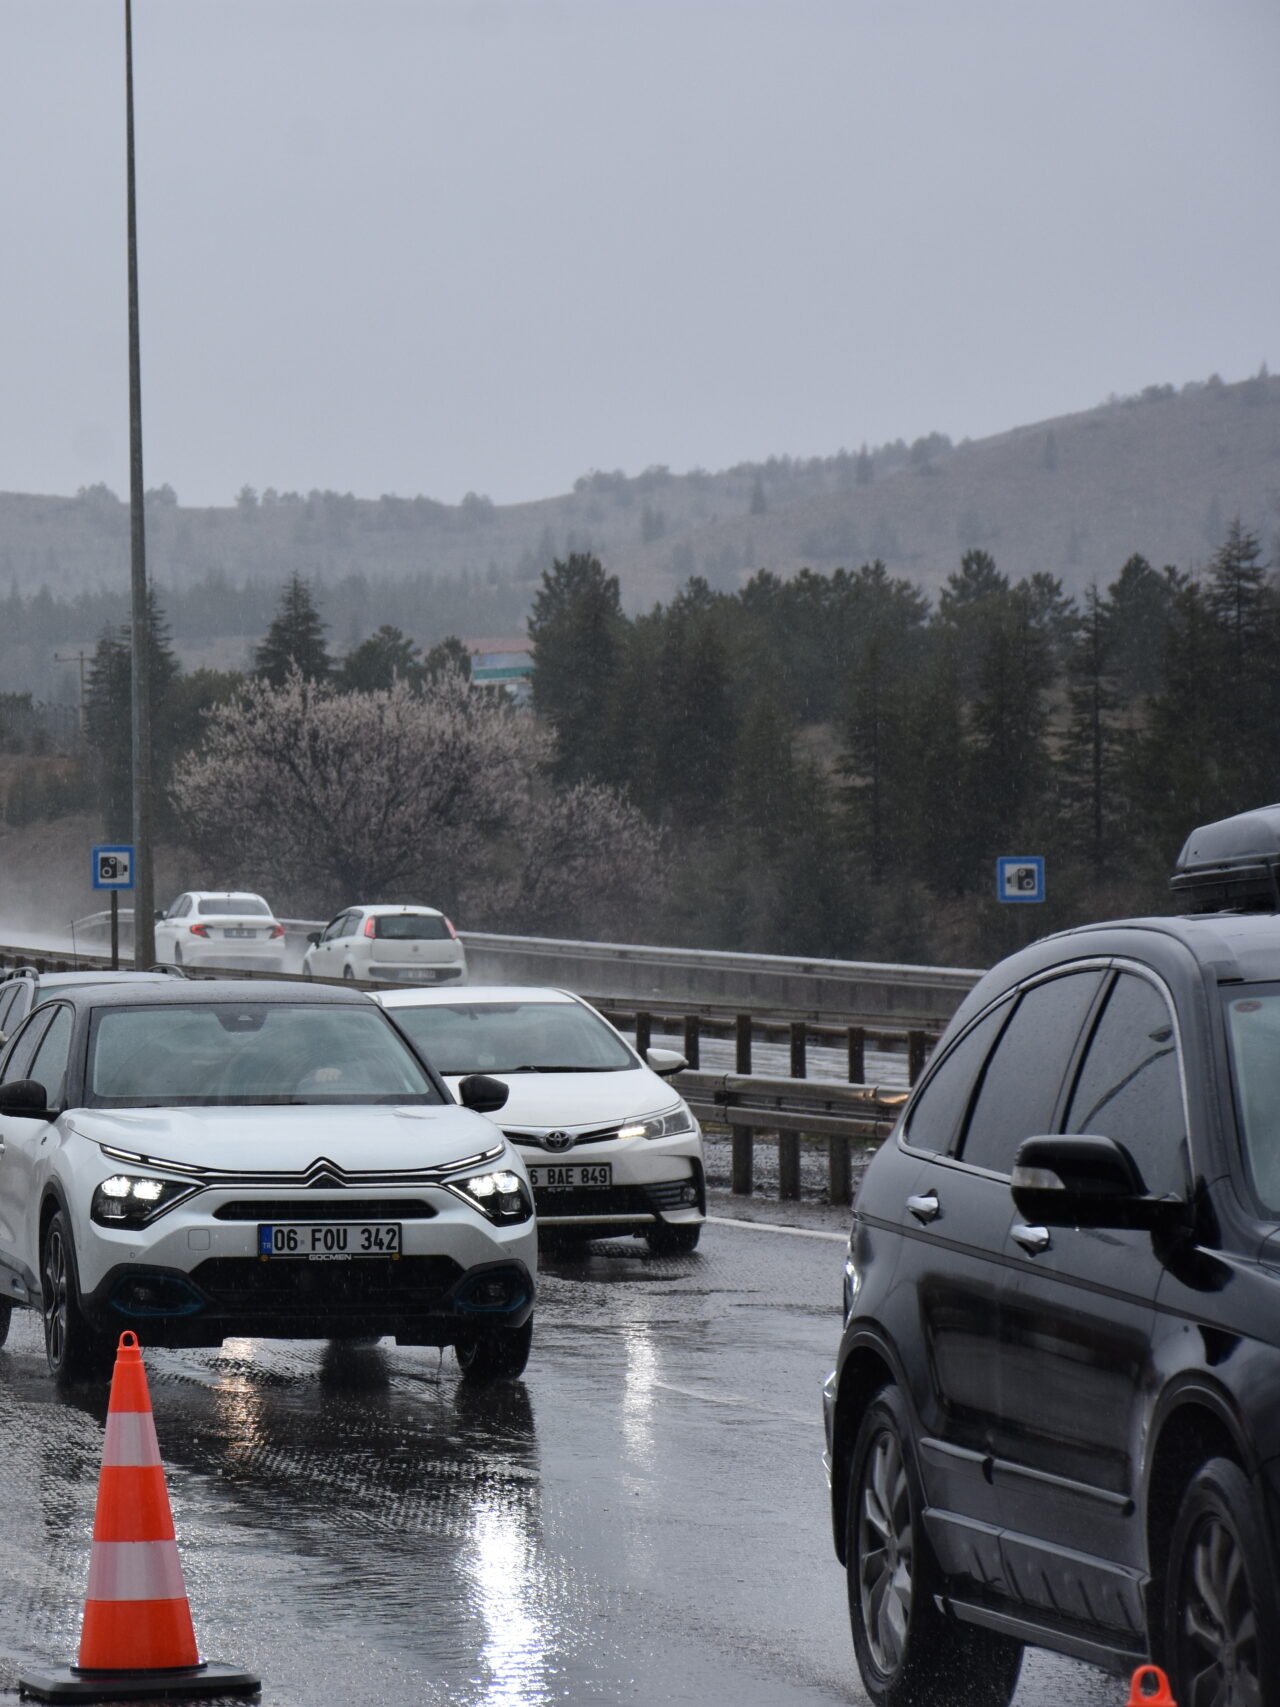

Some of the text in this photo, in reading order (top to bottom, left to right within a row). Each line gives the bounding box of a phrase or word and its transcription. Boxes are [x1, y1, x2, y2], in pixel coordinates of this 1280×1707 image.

[528, 1167, 608, 1186] 6 BAE 849
[273, 1228, 299, 1251] 06
[310, 1228, 348, 1251] FOU
[360, 1227, 397, 1250] 342
